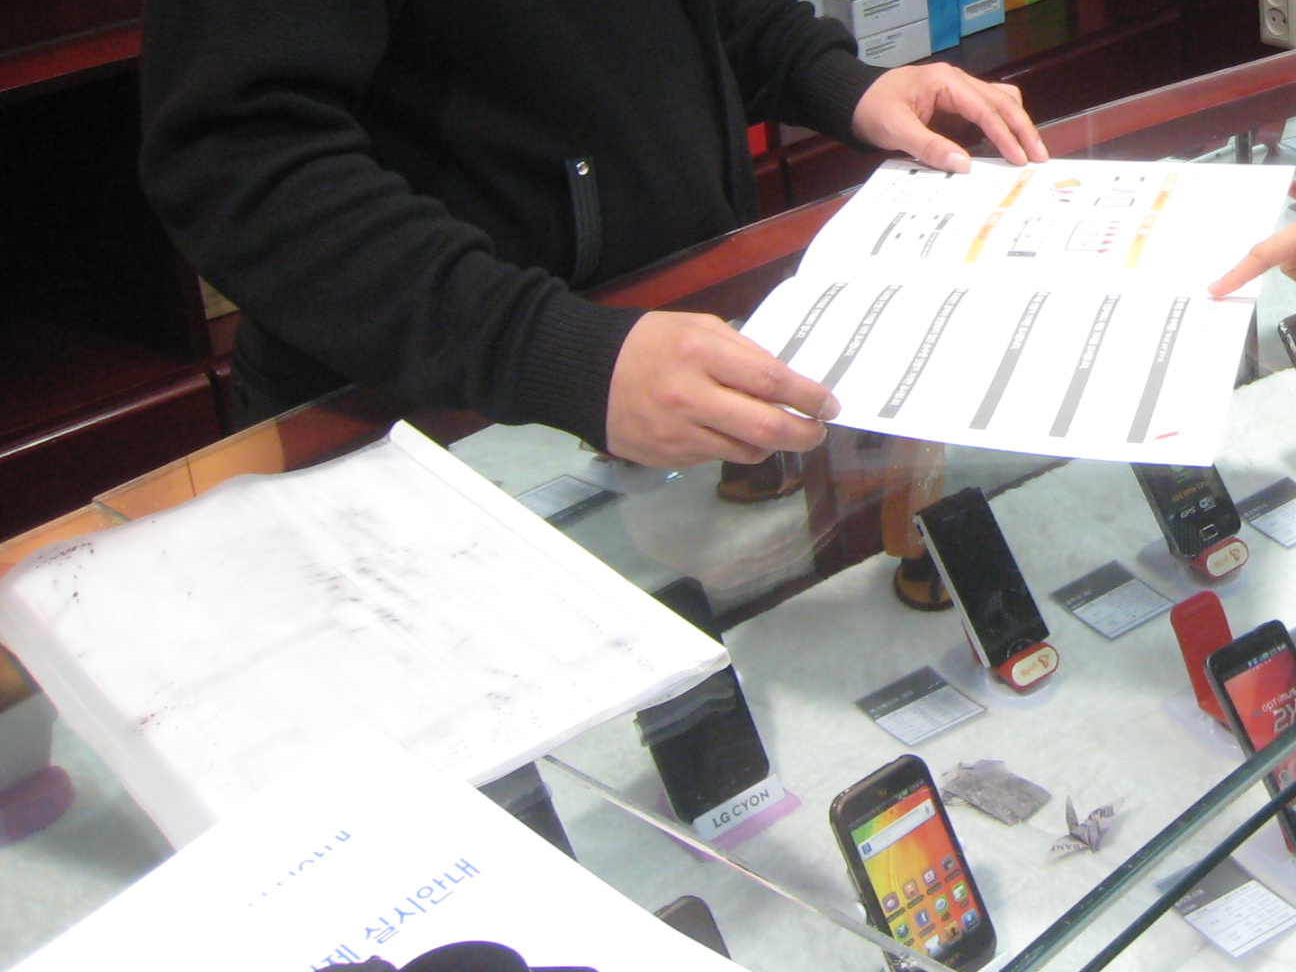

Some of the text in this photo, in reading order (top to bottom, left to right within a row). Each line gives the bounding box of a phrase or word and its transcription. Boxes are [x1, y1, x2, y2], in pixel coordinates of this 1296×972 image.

[712, 789, 770, 829] LG CYON
[364, 858, 481, 945] 실시안내
